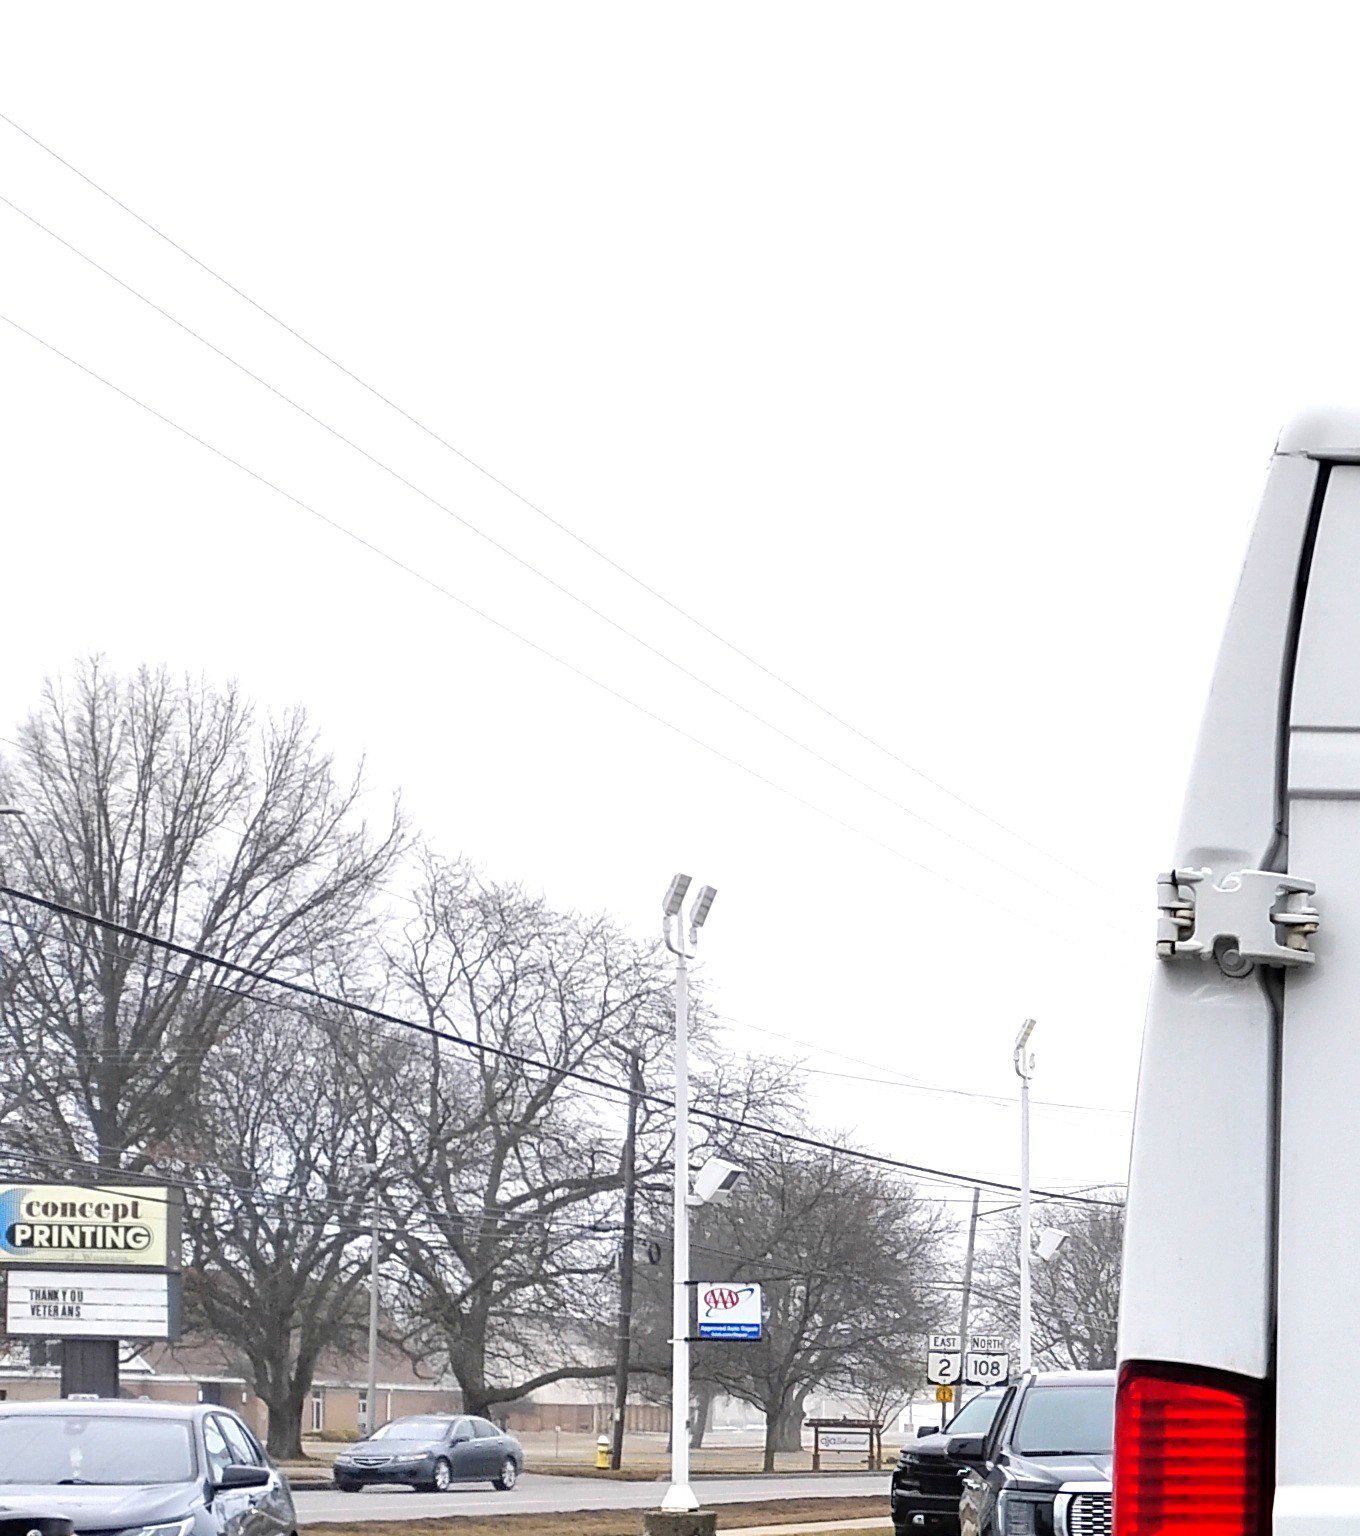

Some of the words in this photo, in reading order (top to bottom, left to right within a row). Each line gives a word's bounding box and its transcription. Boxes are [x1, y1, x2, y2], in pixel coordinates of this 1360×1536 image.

[25, 1200, 141, 1223] concept
[14, 1224, 151, 1250] PRINTING
[29, 1289, 59, 1301] THANK
[61, 1290, 84, 1302] YOU
[706, 1288, 737, 1310] AAA
[30, 1305, 82, 1318] VETERANS
[933, 1336, 957, 1348] EAST
[972, 1338, 1003, 1349] NORTH
[938, 1359, 951, 1377] 2
[973, 1360, 1001, 1377] 108
